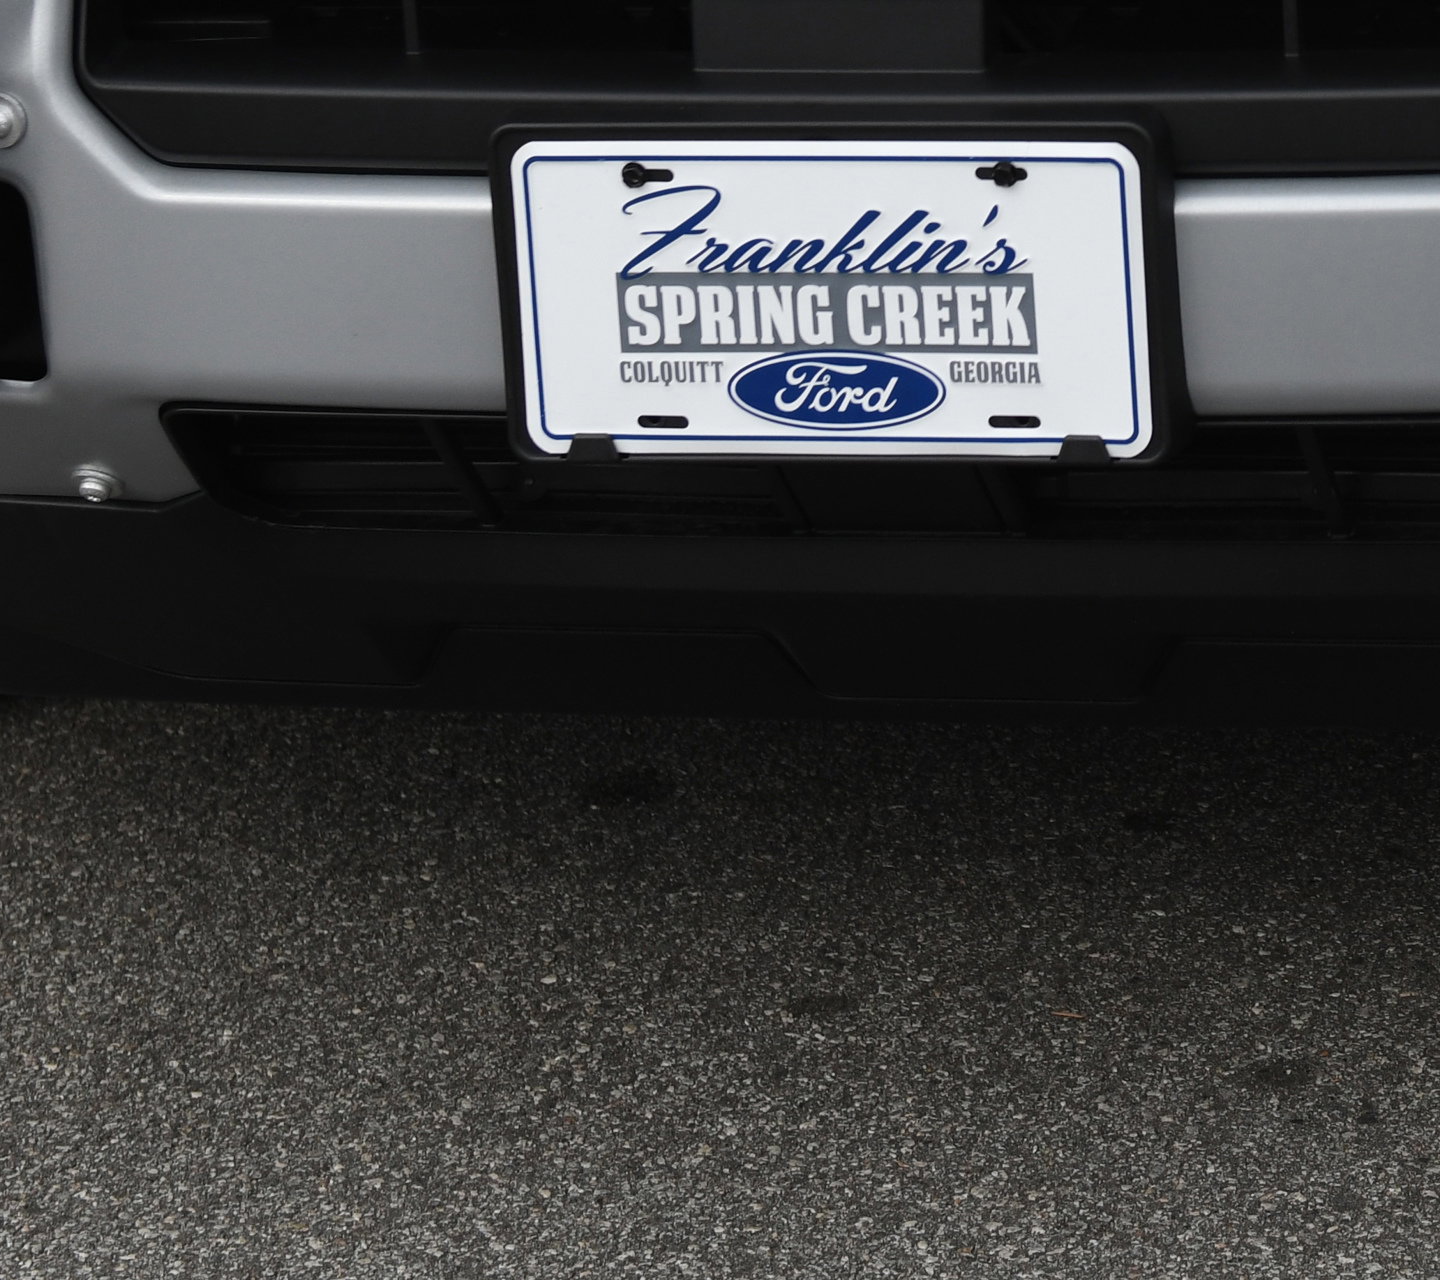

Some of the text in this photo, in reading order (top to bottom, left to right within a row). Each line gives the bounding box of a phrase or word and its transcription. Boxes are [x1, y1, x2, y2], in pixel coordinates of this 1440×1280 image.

[620, 185, 1029, 279] Franklin's
[625, 283, 1032, 347] SPRING CREEK
[620, 361, 724, 385] COLQUITT
[774, 363, 898, 413] Ford
[948, 361, 1041, 384] GEORGIA
